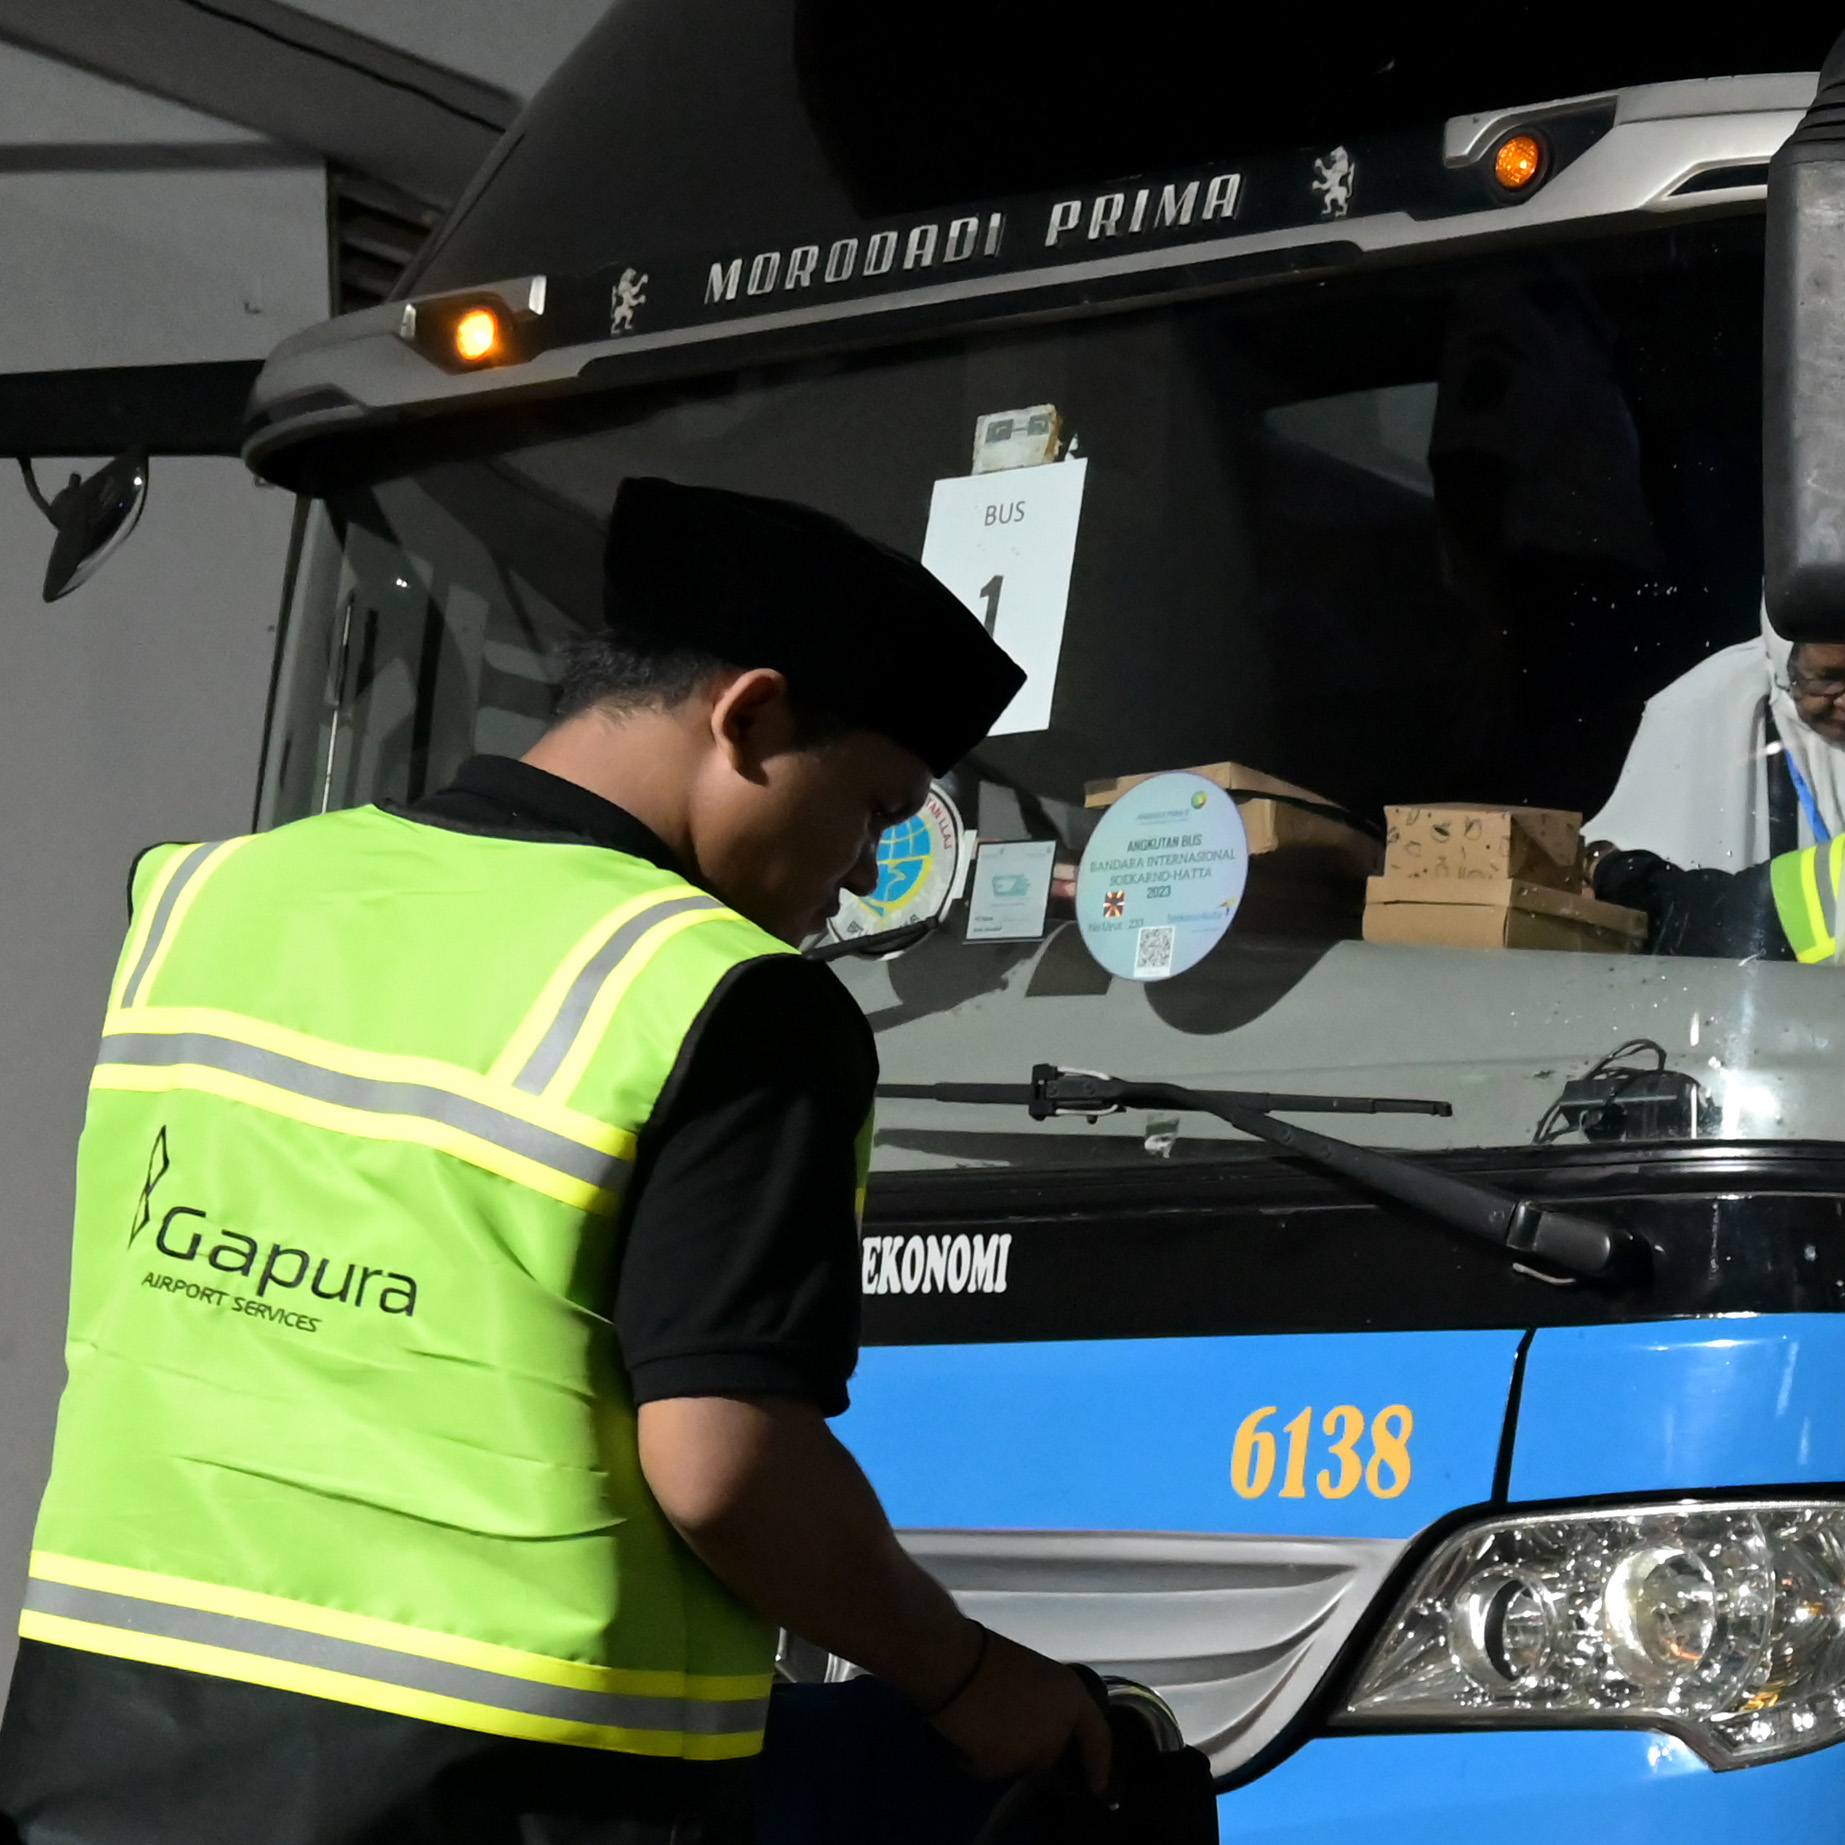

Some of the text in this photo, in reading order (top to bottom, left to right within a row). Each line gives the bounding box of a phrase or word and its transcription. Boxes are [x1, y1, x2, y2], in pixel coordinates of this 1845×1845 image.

[704, 173, 1242, 305] MORODADI PRIMA
[984, 501, 1026, 526] BUS
[979, 575, 1004, 638] 1
[1090, 848, 1236, 872] BANDARA INTERNASIONAL
[1127, 834, 1203, 852] ANGKUTAN BUS
[1146, 885, 1172, 899] 2023
[156, 1206, 417, 1316] Gapura
[862, 1233, 1013, 1295] EKONOMI
[141, 1272, 322, 1333] AIRPORT SERVICES
[1230, 1404, 1414, 1499] 6138
